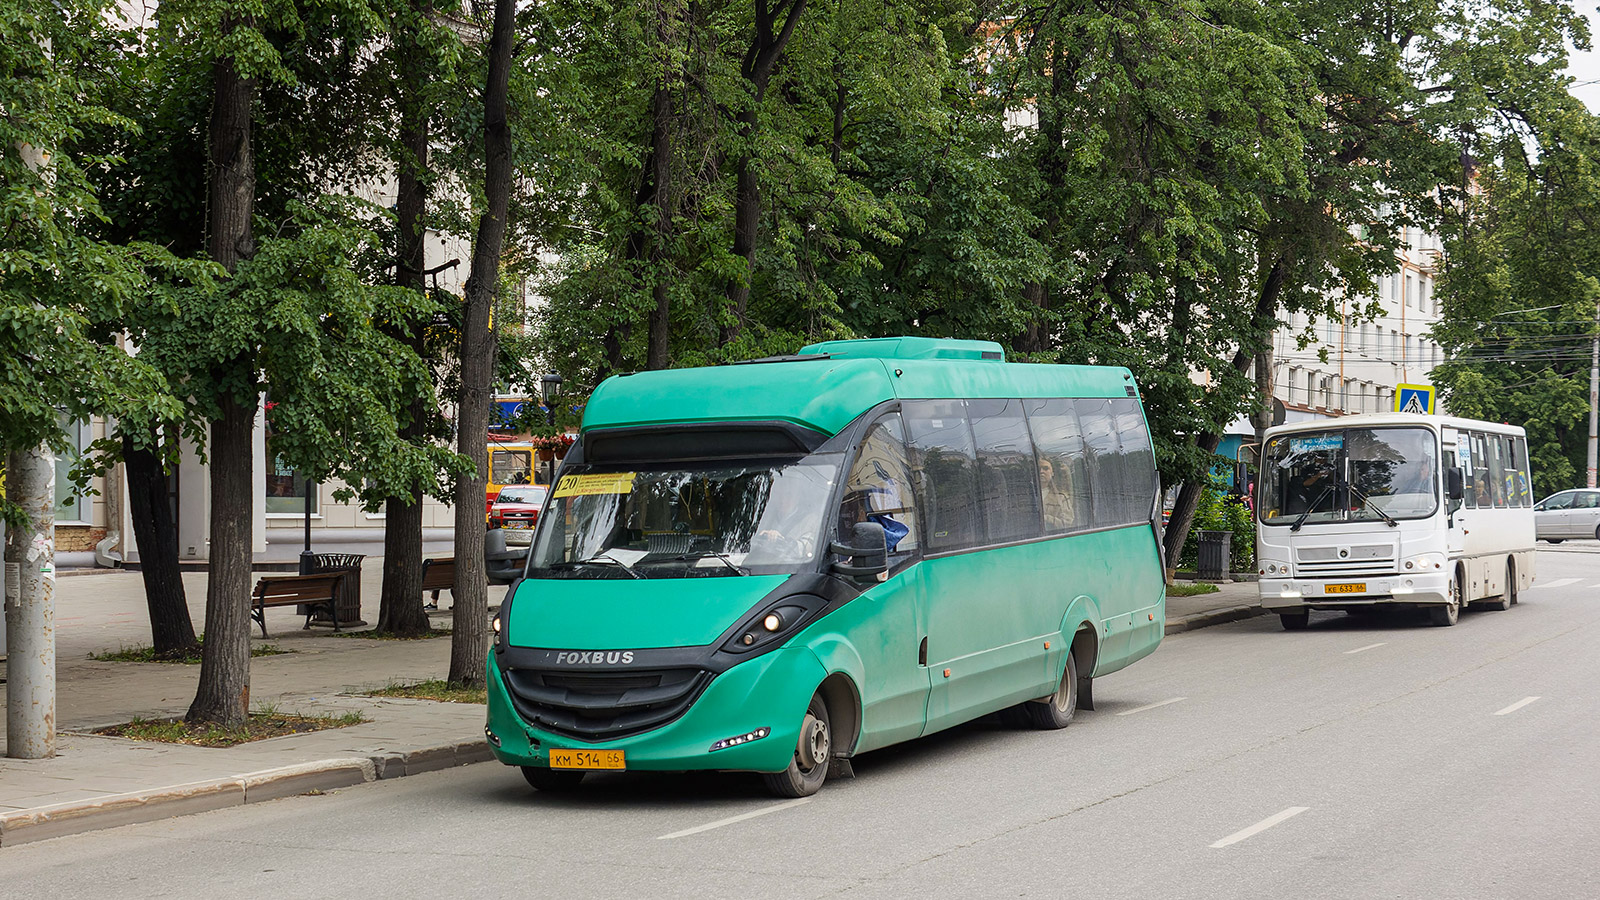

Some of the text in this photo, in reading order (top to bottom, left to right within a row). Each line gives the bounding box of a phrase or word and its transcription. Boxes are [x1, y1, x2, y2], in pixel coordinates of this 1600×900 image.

[556, 477, 577, 491] 120
[1340, 585, 1353, 593] 633
[556, 651, 634, 664] FOXBUS
[555, 755, 571, 766] КМ
[576, 753, 600, 766] 514
[607, 752, 620, 763] 66
